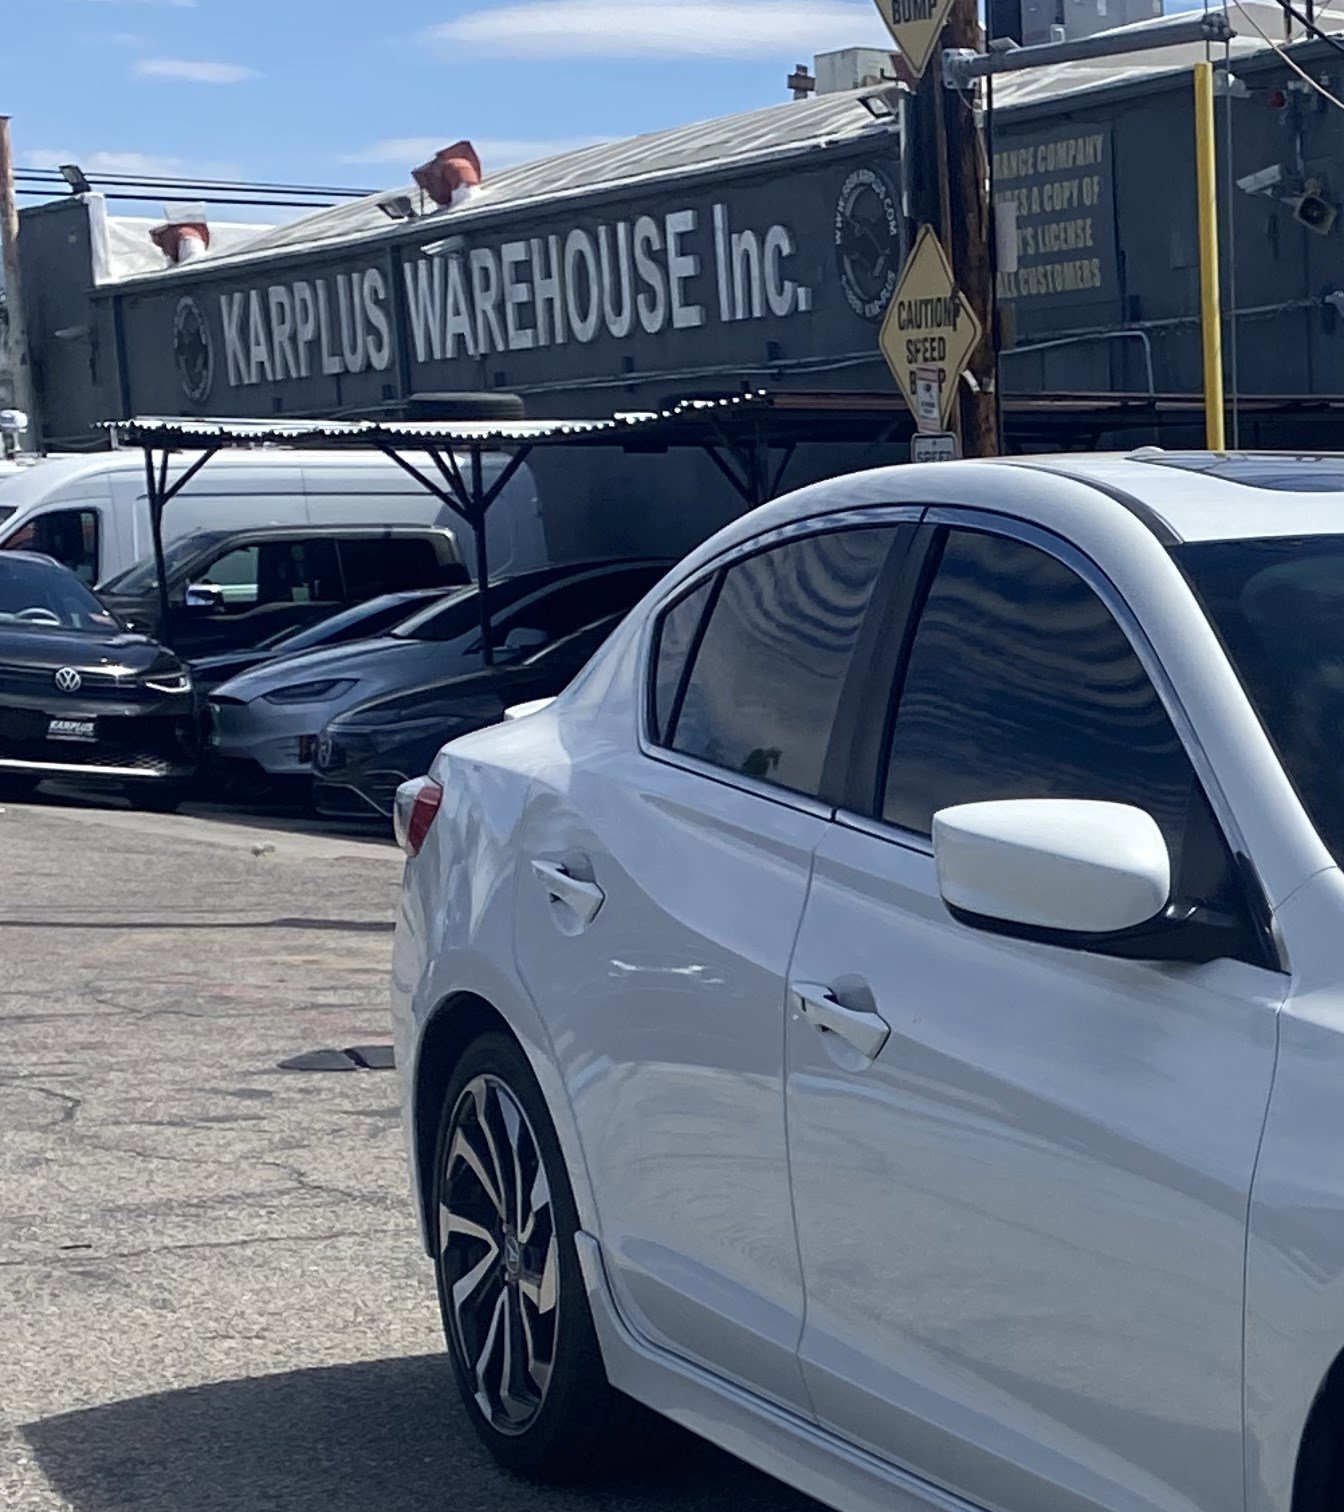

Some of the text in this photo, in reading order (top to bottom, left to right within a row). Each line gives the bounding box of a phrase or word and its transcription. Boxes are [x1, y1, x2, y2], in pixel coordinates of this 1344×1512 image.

[1037, 133, 1104, 173] COMPANY
[1043, 179, 1080, 212] COPY
[1082, 176, 1100, 207] OF
[1038, 217, 1093, 252] LICENSE
[220, 268, 391, 387] KARPLUS
[404, 209, 705, 363] WAREHOUSE
[712, 203, 812, 323] Inc.
[1019, 258, 1101, 296] CUSTOMERS
[906, 336, 946, 364] SPEED
[909, 367, 946, 395] BP
